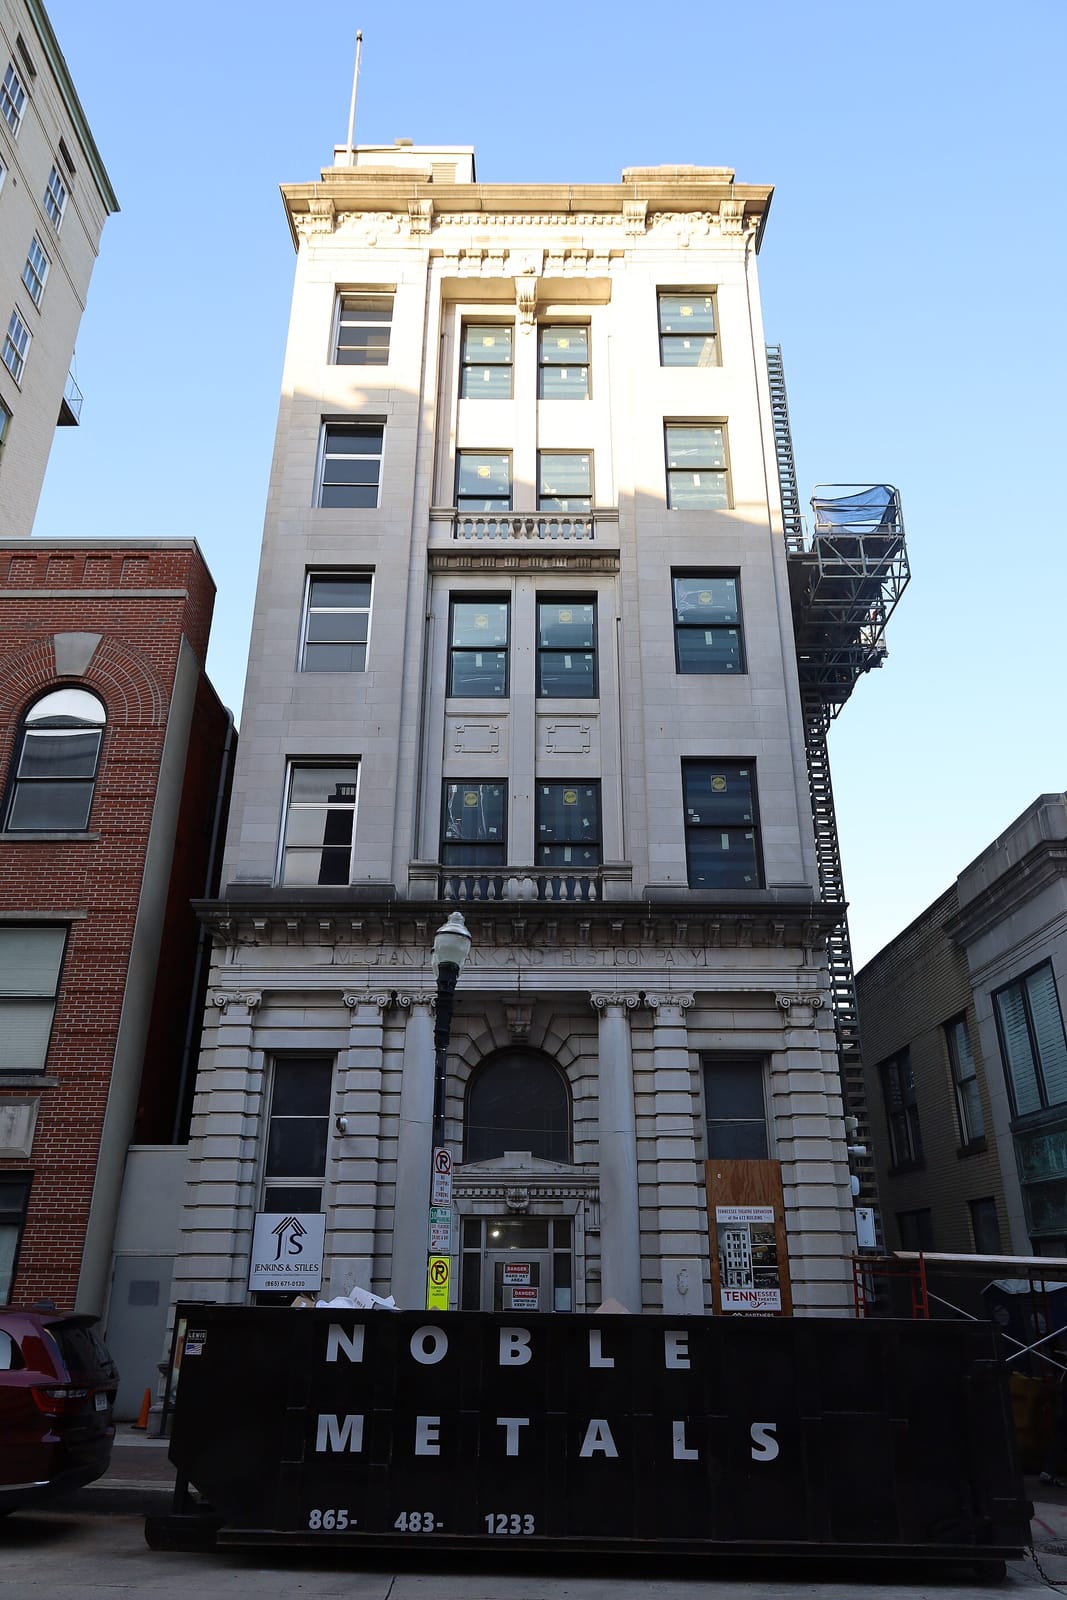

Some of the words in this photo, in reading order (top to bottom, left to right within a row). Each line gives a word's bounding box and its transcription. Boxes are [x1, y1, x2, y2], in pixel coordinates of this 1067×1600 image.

[461, 947, 501, 966] ANK
[504, 948, 545, 966] AND
[547, 948, 610, 967] TRUST
[614, 948, 703, 967] COMPANY
[254, 1263, 285, 1273] JENKINS
[285, 1264, 292, 1272] &
[294, 1263, 319, 1272] STILES
[326, 1323, 692, 1370] NOBLE
[315, 1413, 780, 1462] METALS
[308, 1509, 358, 1530] 865-
[394, 1511, 444, 1533] 483-
[484, 1512, 536, 1535] 1233
